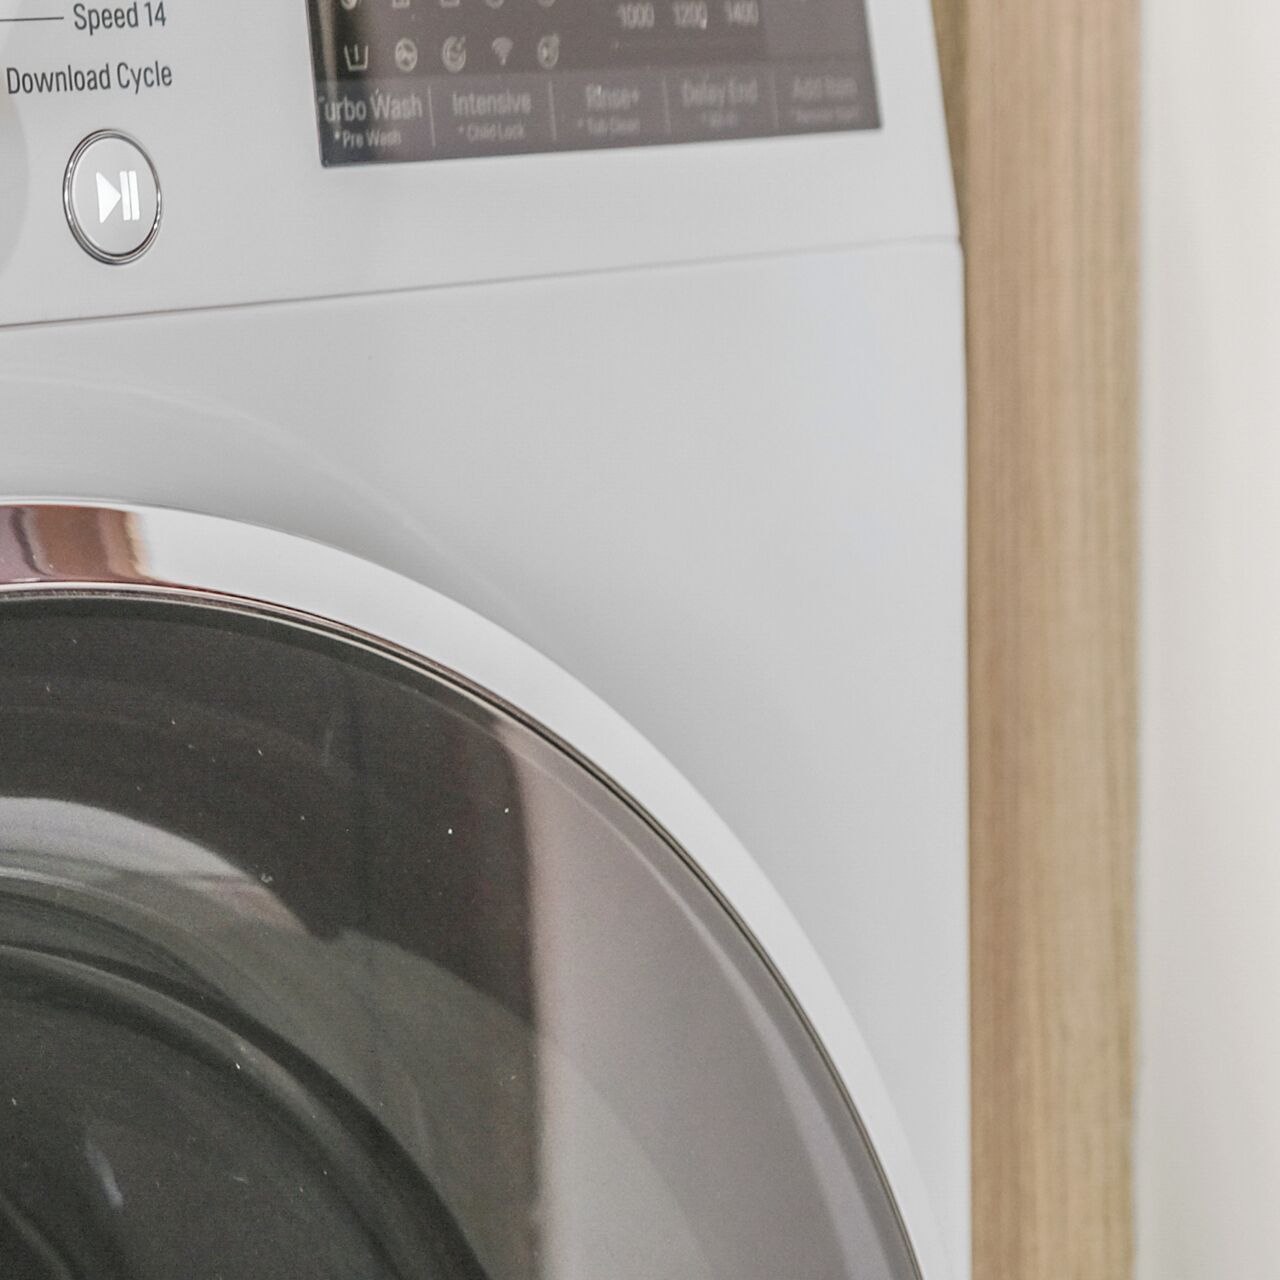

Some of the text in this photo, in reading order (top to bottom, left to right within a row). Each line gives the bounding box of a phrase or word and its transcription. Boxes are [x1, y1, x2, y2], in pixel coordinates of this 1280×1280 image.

[73, 2, 167, 36] Speed 14
[7, 60, 173, 94] Download Cycle
